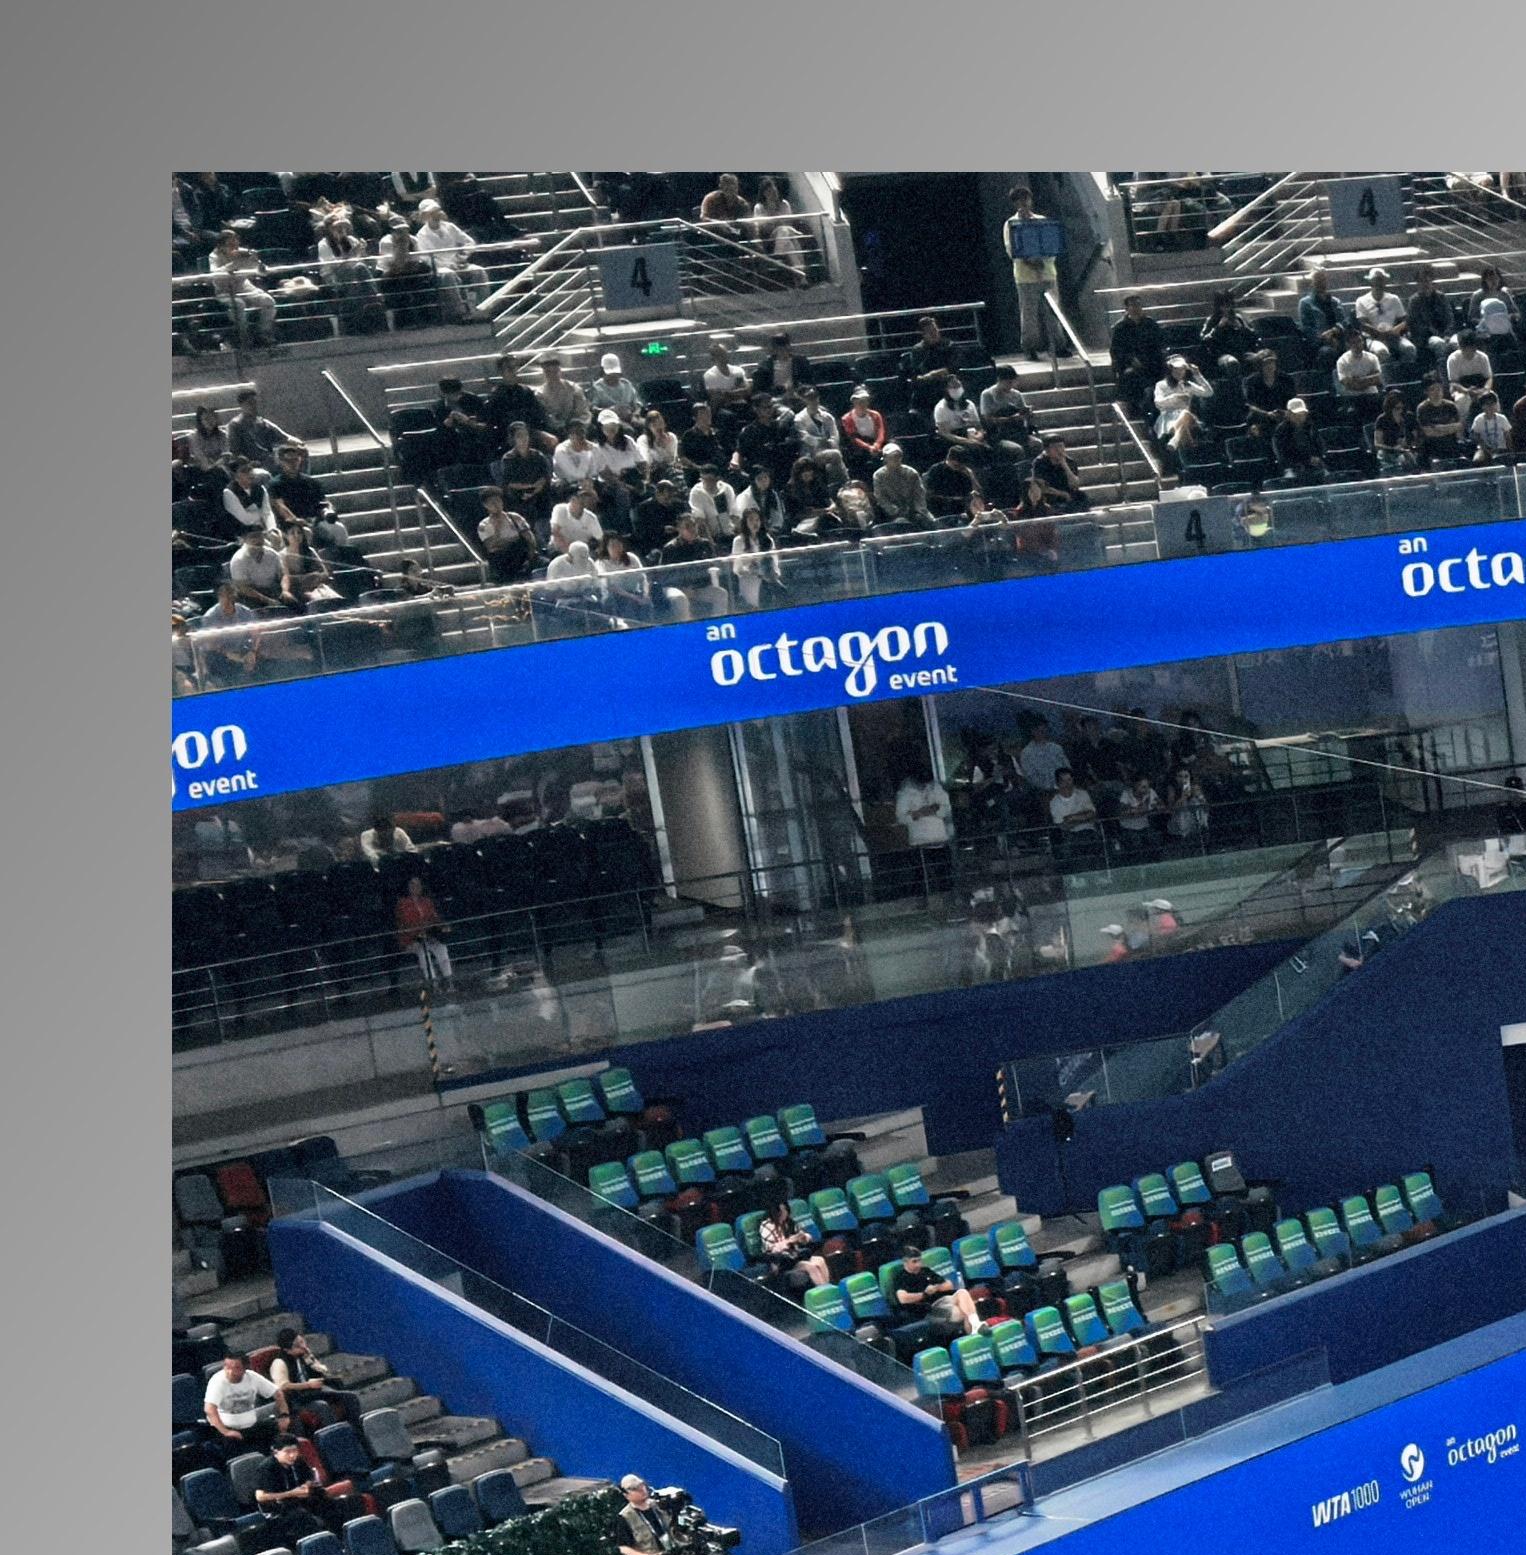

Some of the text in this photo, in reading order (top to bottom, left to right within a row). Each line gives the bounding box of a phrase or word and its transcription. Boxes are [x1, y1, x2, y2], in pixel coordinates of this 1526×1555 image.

[630, 257, 653, 297] 4
[1399, 537, 1427, 554] an
[706, 623, 735, 641] an
[711, 621, 949, 697] octagon
[889, 665, 959, 690] event
[188, 769, 259, 799] event
[1448, 1424, 1517, 1466] octagon
